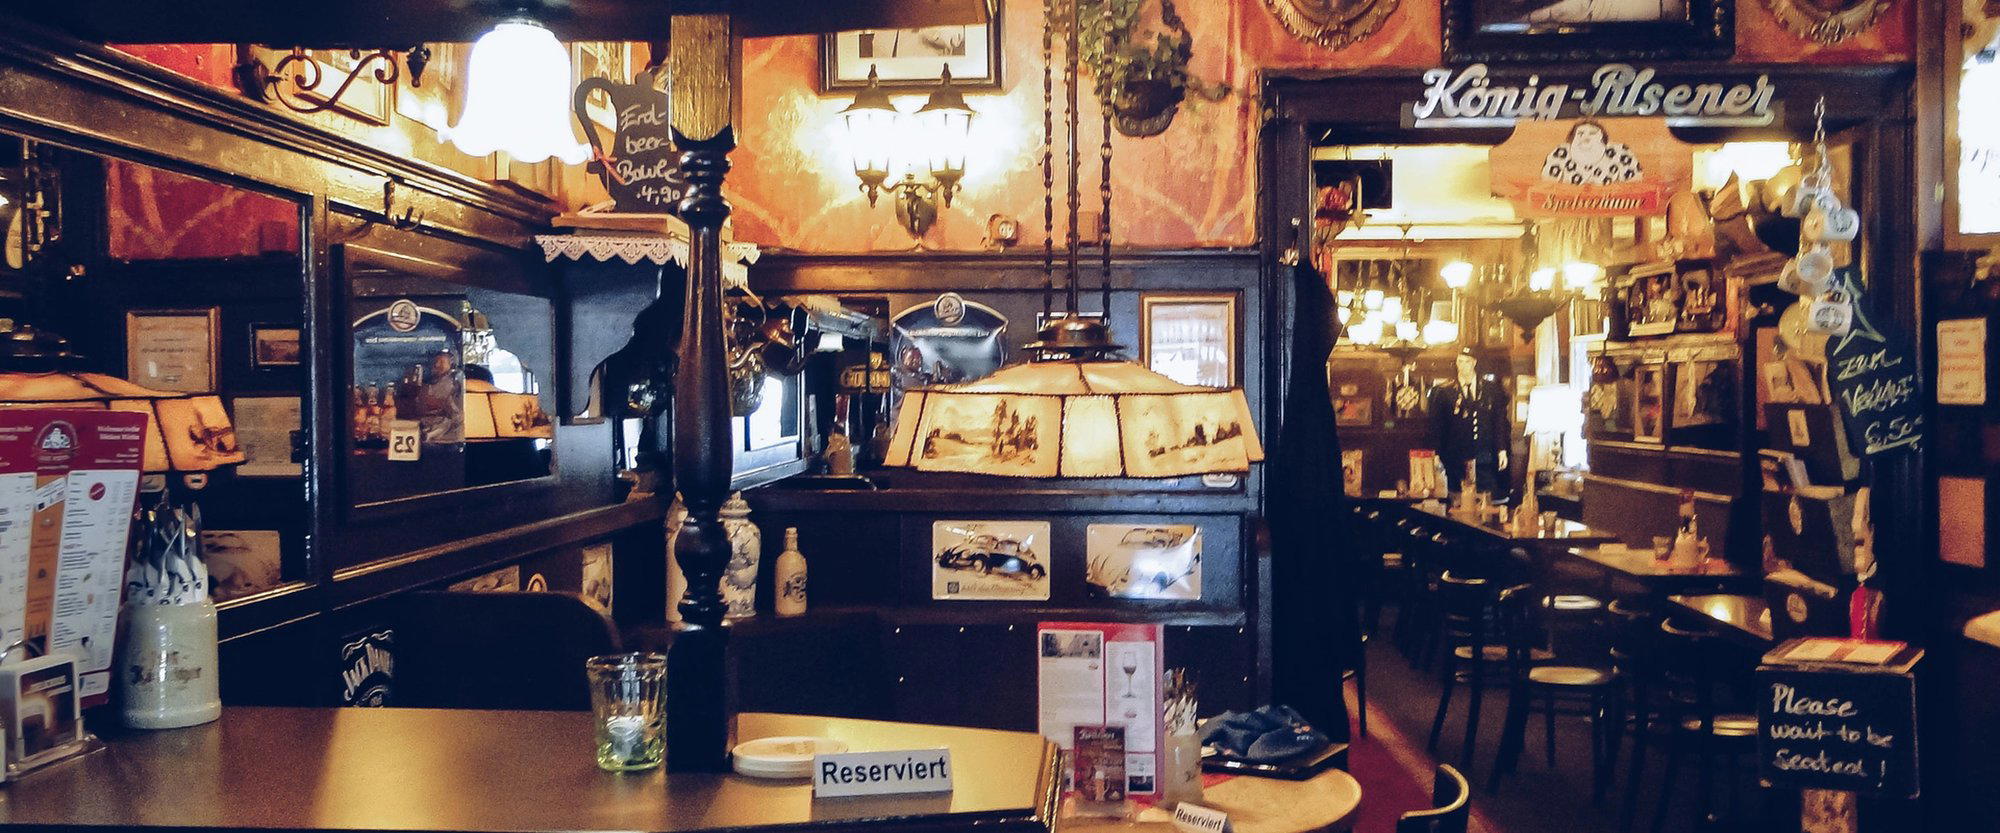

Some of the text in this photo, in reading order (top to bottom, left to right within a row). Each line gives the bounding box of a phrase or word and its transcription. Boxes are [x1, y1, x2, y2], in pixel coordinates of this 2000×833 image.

[620, 103, 667, 131] Erd-
[616, 159, 684, 186] Bowle
[1771, 682, 1858, 717] Please
[1770, 721, 1831, 741] wait
[1837, 724, 1861, 743] to
[821, 756, 947, 785] Reserviert
[1175, 808, 1222, 832] Reserviert
